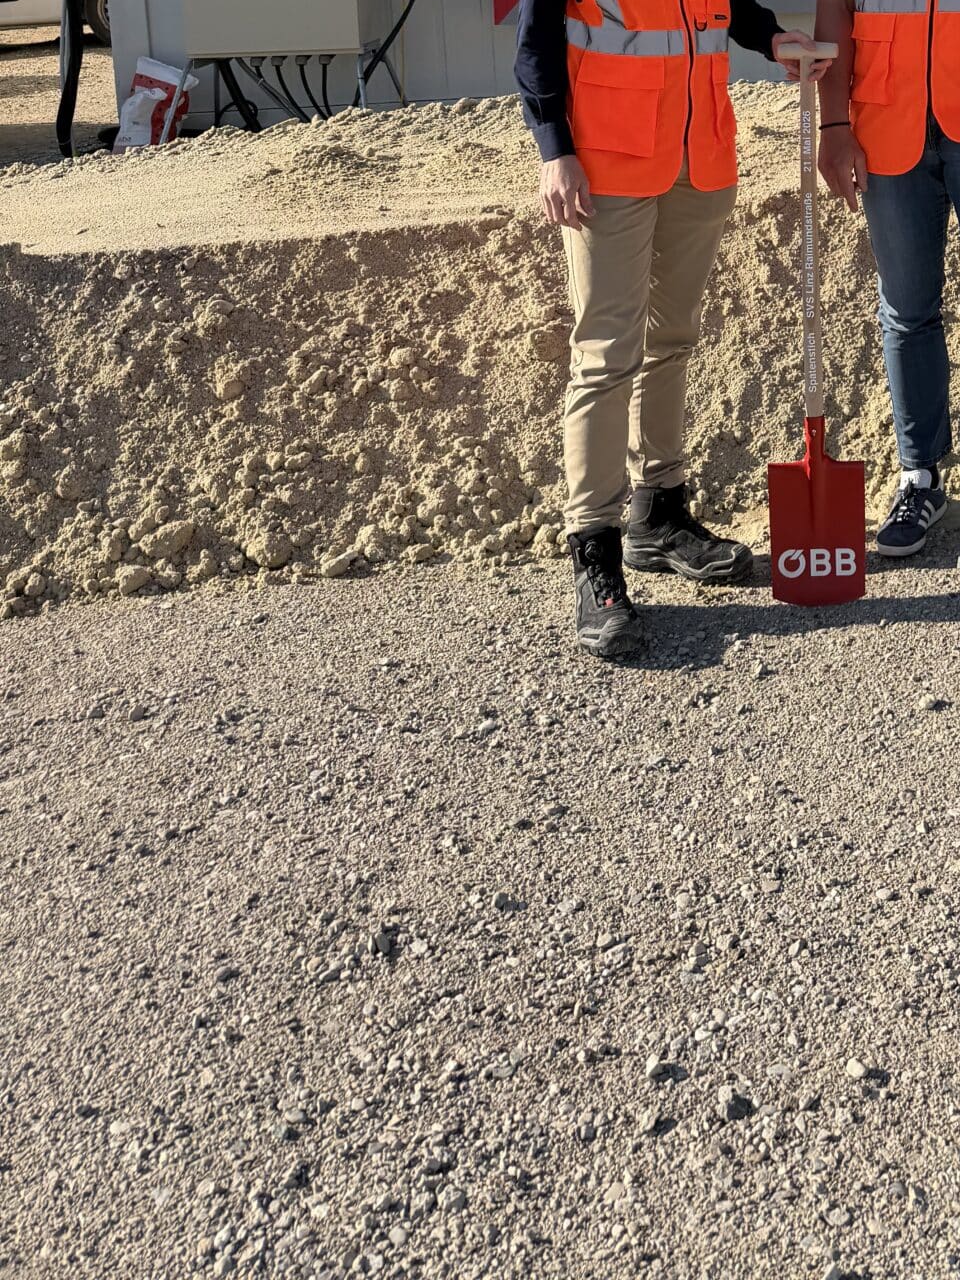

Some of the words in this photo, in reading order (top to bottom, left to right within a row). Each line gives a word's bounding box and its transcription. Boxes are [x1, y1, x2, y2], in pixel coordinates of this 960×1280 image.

[803, 135, 812, 155] Mai
[804, 192, 814, 269] Raimundstraße
[805, 272, 814, 294] Linz
[806, 296, 815, 318] SVS
[807, 332, 817, 393] Spatenstich
[778, 547, 857, 579] ÖBB
